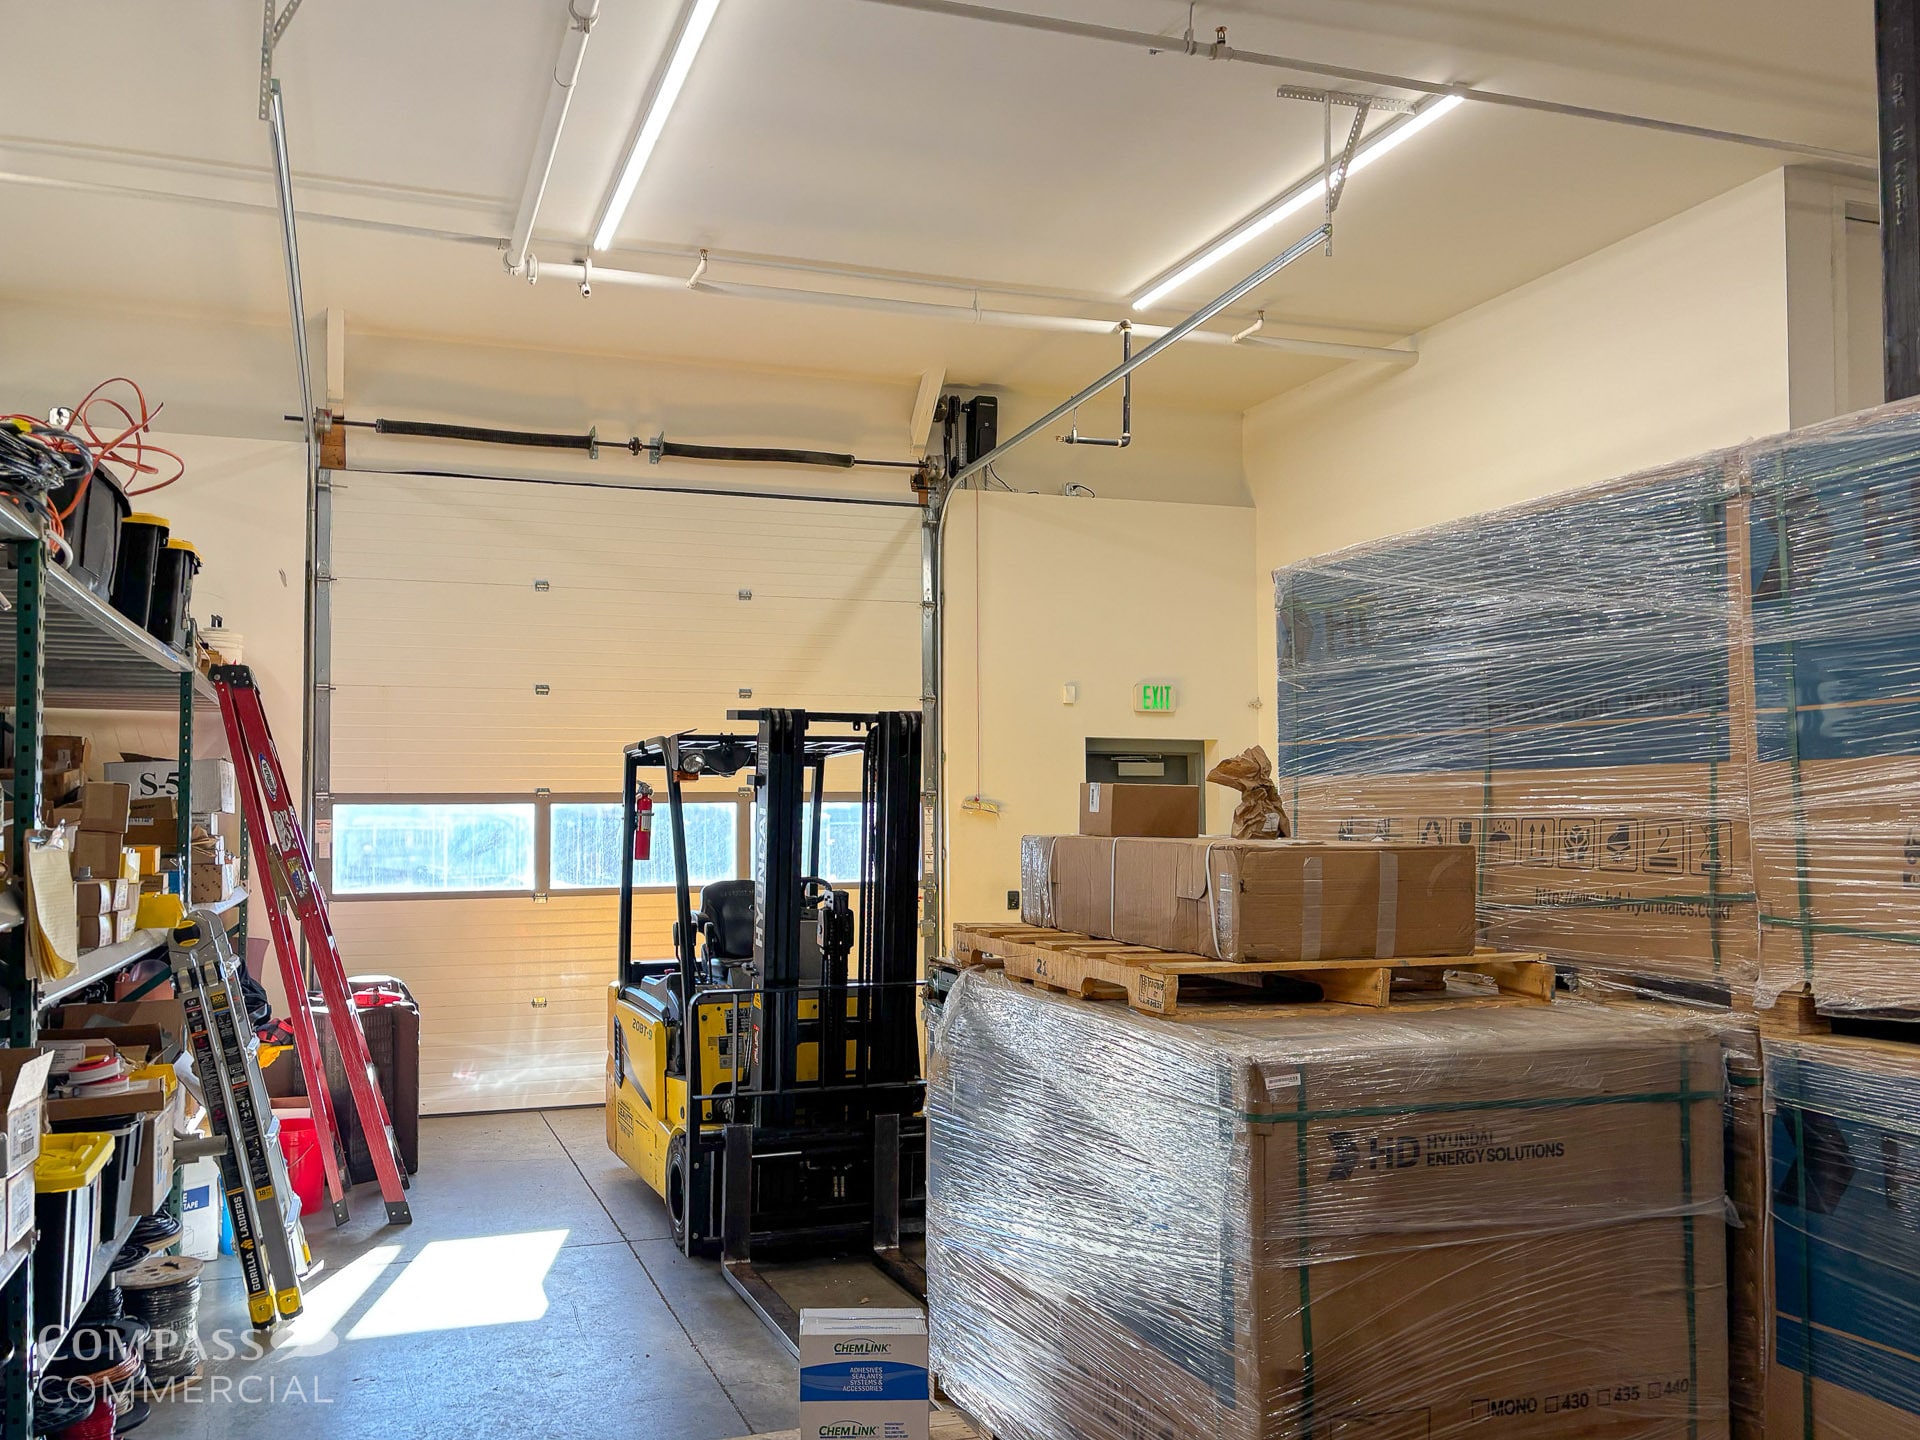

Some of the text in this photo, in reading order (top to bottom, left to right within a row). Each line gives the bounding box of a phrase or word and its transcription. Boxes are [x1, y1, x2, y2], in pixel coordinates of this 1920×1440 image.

[1143, 685, 1172, 710] EXIT
[755, 807, 769, 948] HYUNDAI
[1036, 958, 1048, 976] 21
[1369, 1136, 1420, 1169] HD
[1427, 1131, 1495, 1150] HYUNDAI
[1427, 1142, 1565, 1167] ENERGY SOLUTIONS
[234, 1196, 261, 1291] GORILLA LADDERS
[849, 1366, 883, 1374] ADHESIVES
[1491, 1397, 1538, 1416] MONO
[1561, 1392, 1590, 1410] 430
[1613, 1386, 1641, 1402] 435
